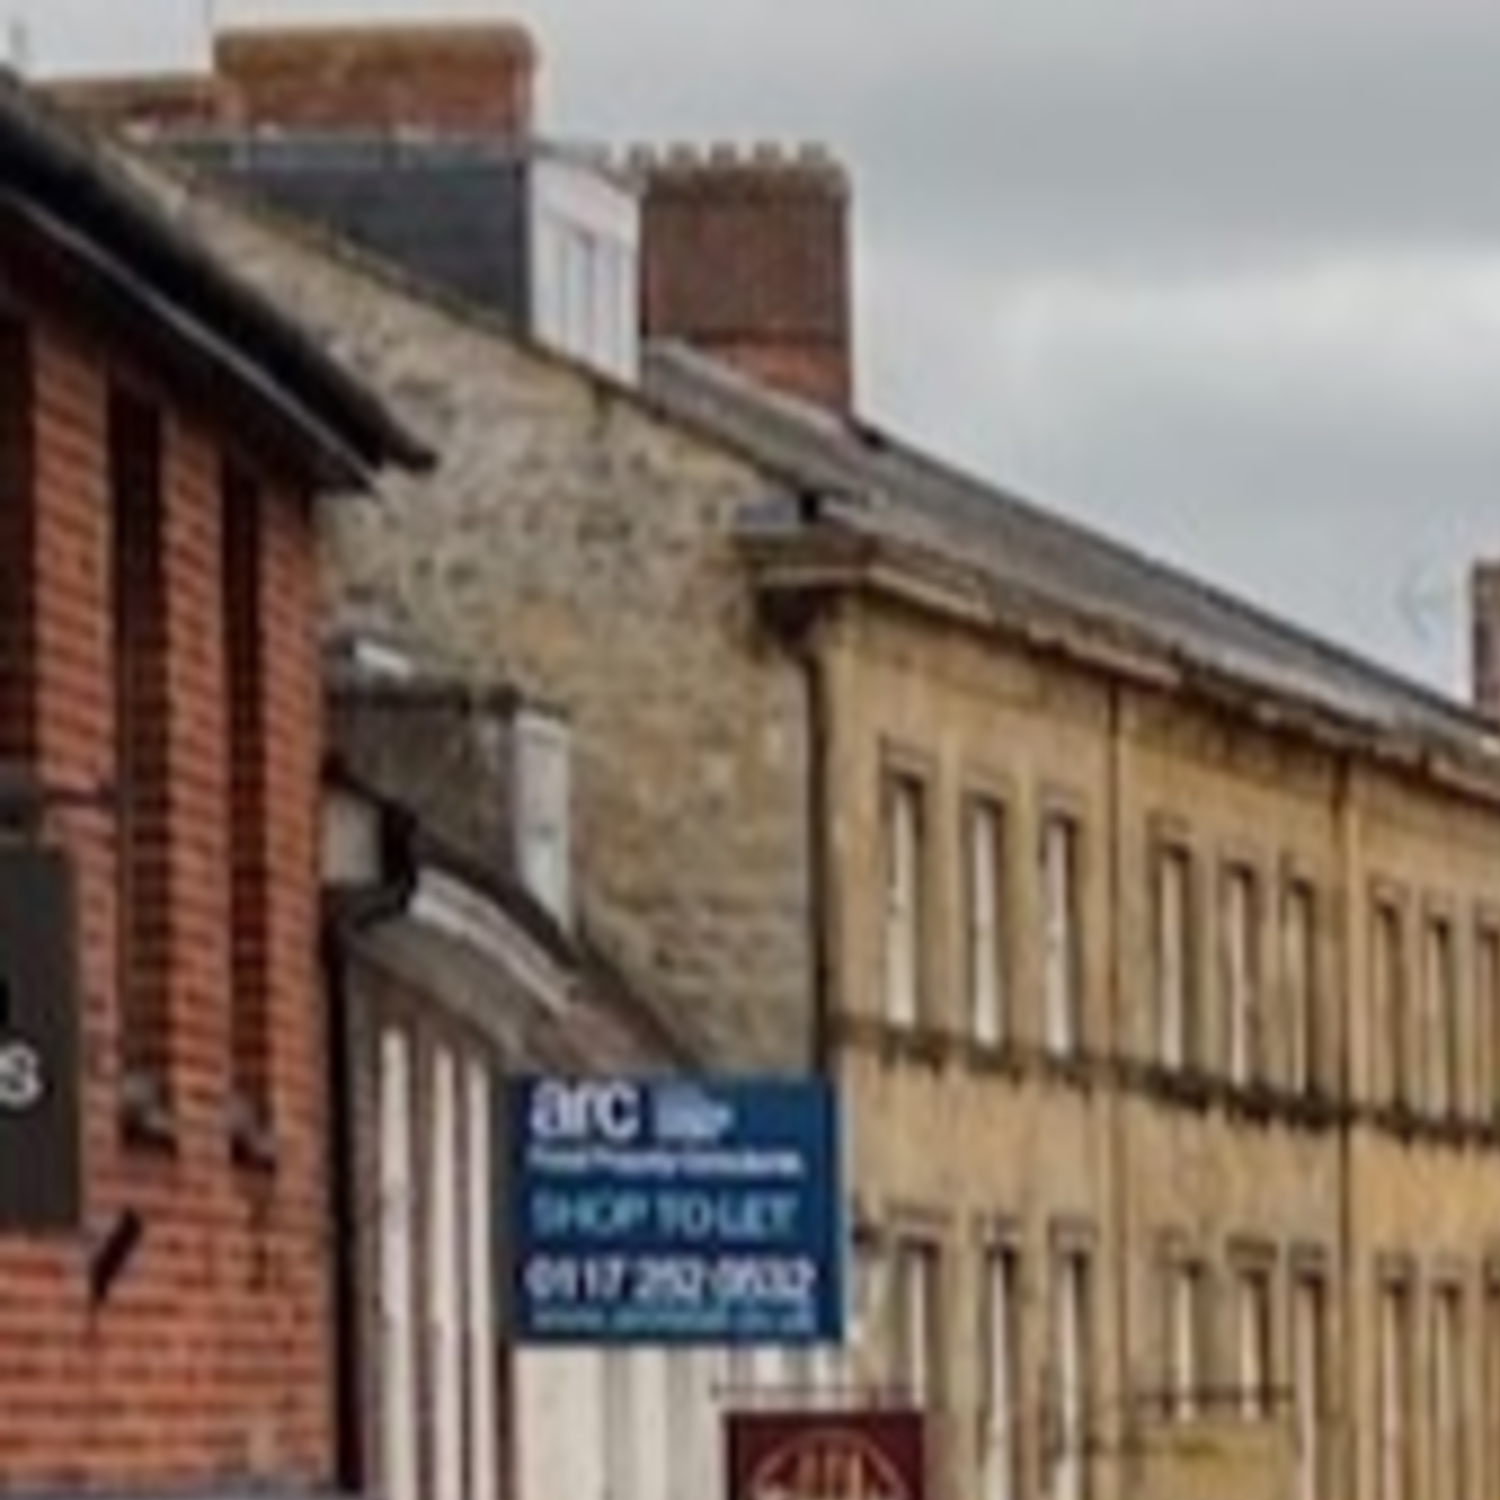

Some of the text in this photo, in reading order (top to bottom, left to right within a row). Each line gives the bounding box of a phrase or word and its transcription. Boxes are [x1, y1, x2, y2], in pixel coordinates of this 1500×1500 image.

[530, 1078, 641, 1139] arc
[531, 1190, 800, 1240] SHOP TO LET
